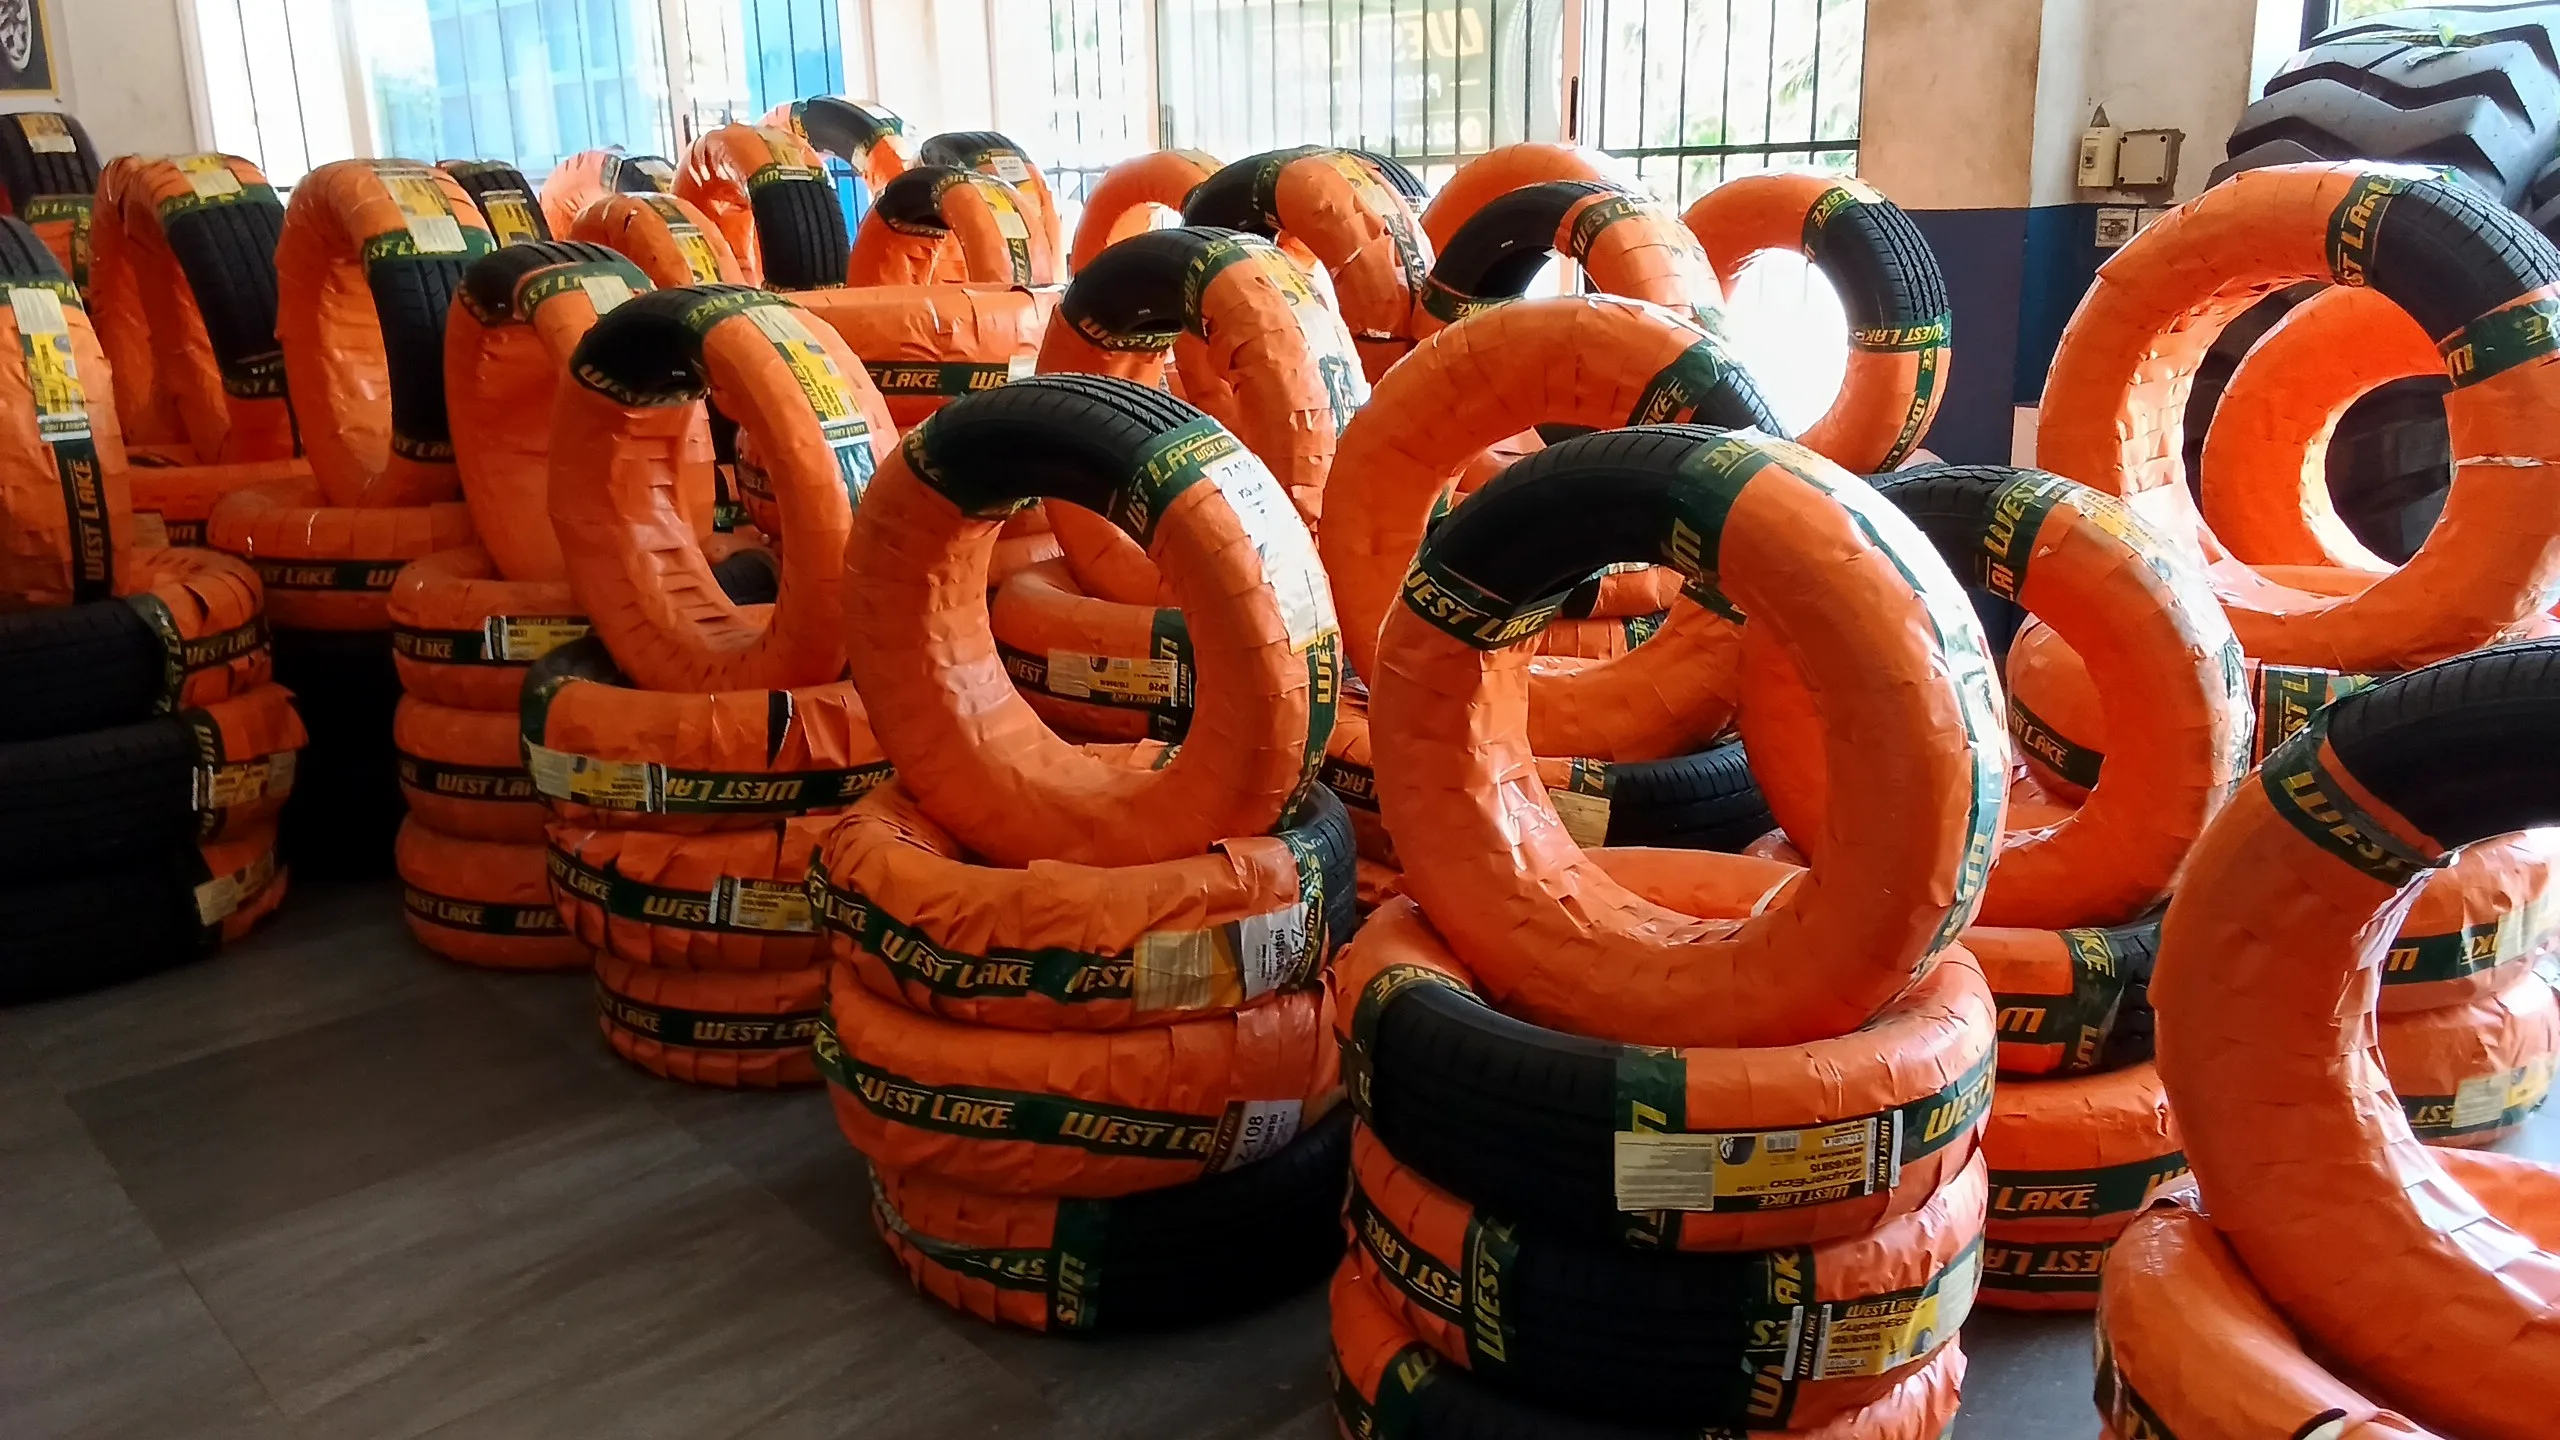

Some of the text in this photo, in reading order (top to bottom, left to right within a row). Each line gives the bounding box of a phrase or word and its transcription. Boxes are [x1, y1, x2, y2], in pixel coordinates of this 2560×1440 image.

[1812, 187, 1850, 227] LAKE
[1573, 202, 1642, 255] WEST LA
[2342, 253, 2364, 287] ST
[1921, 348, 1934, 371] KE
[881, 370, 1008, 390] LAKE WE
[1984, 481, 2036, 560] WEST
[285, 568, 336, 585] LAKE
[1473, 610, 1553, 643] LAKE
[1007, 656, 1043, 683] WEST
[2026, 726, 2070, 767] LAKE
[436, 773, 532, 797] WEST LA
[719, 780, 803, 800] WEST
[569, 867, 614, 900] LAKE
[438, 902, 486, 927] LAKE
[515, 911, 564, 930] WE
[826, 895, 867, 933] LAKE
[881, 930, 1034, 990] WEST LAKE
[617, 1002, 663, 1033] LAKE
[693, 1021, 820, 1042] WEST LA
[856, 1073, 1014, 1130] WEST LAKE
[1059, 1111, 1215, 1154] WEST LA
[1757, 1184, 1850, 1207] WEST LAKE
[1993, 1187, 2093, 1211] LAKE
[1982, 1248, 2105, 1275] EST LA
[1056, 1252, 1088, 1326] WES
[1412, 1264, 1463, 1306] EST
[1845, 1302, 1889, 1319] WEST
